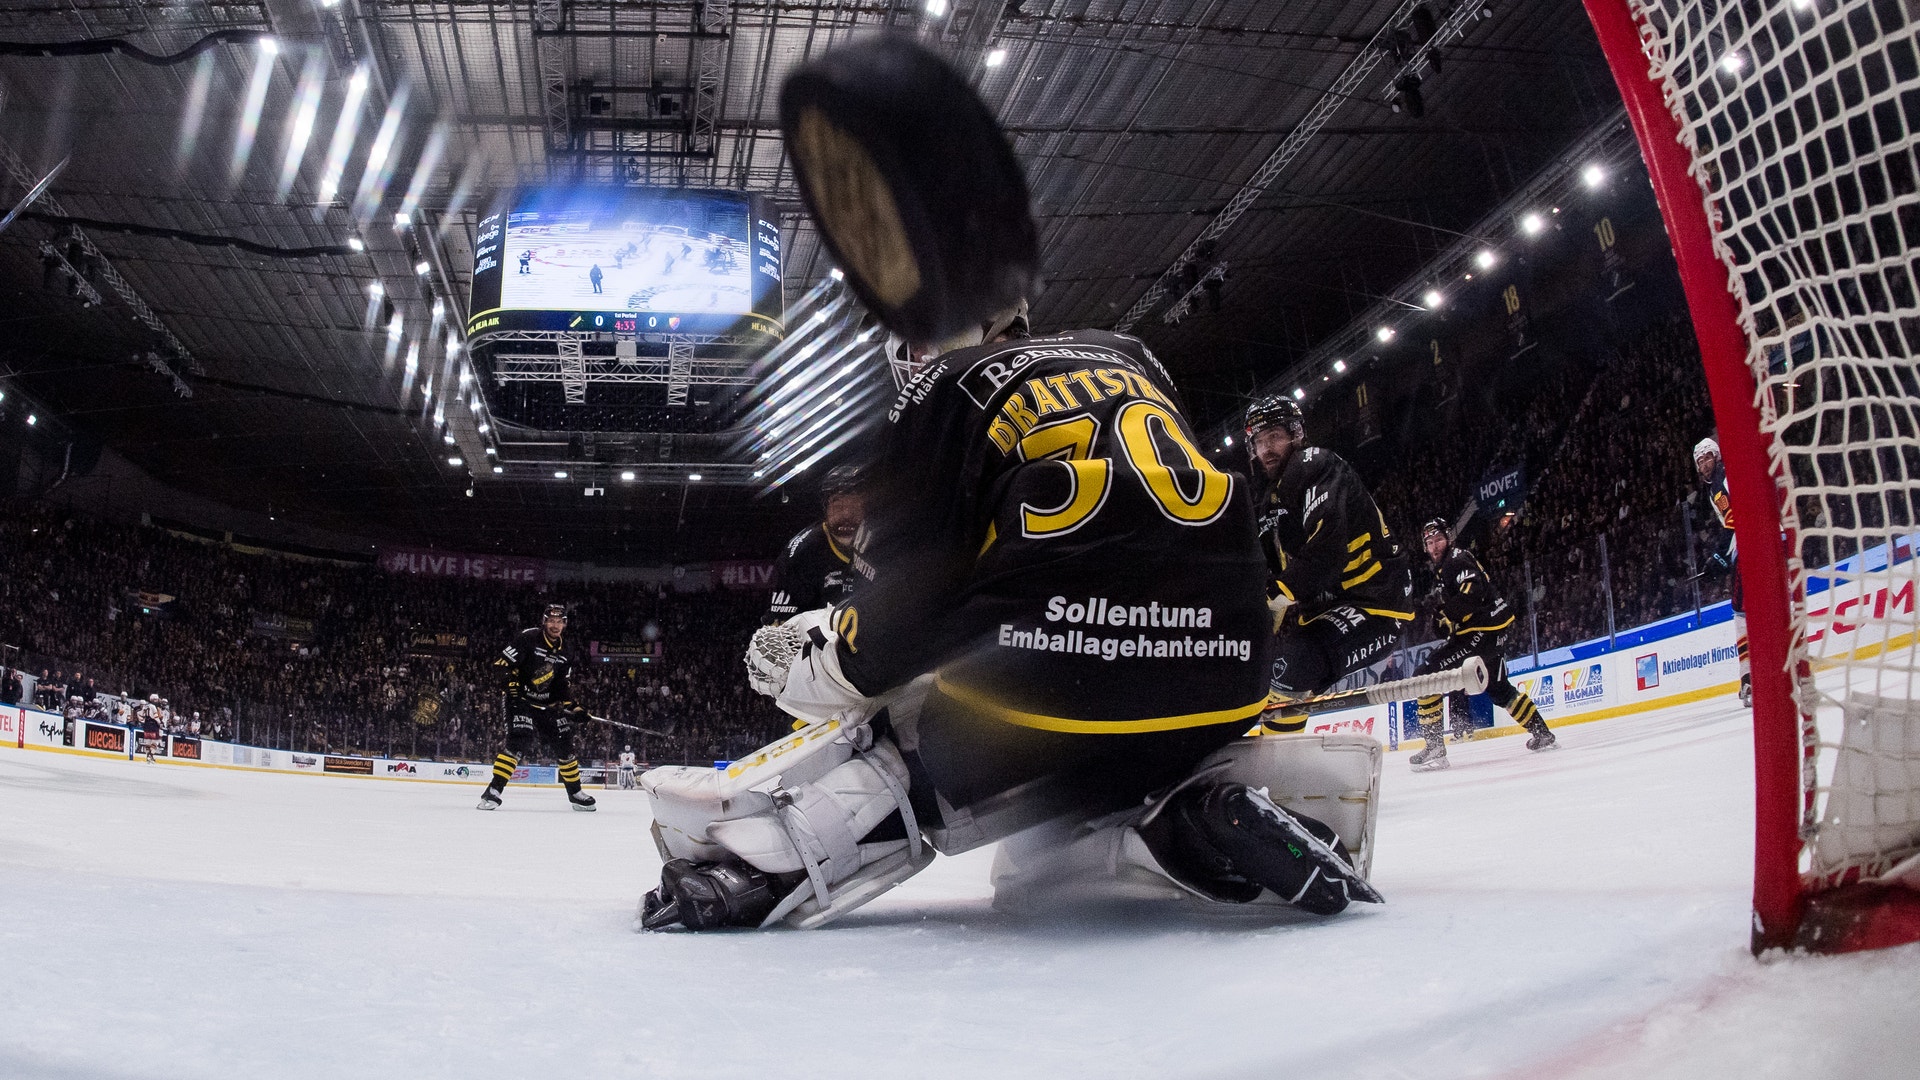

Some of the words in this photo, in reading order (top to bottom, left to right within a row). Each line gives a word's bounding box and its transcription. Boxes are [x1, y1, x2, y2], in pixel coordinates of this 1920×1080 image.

[477, 229, 500, 245] Fabege
[1593, 216, 1616, 252] 10
[1503, 284, 1521, 316] 18
[595, 315, 604, 327] 0
[614, 319, 636, 331] 4:33
[648, 316, 657, 328] 0
[911, 362, 949, 406] Måleri
[987, 367, 1178, 457] BRATTSTR
[1016, 398, 1235, 539] 30
[1479, 470, 1519, 501] HOVET
[463, 557, 486, 579] IS
[1045, 595, 1213, 629] Sollentuna
[998, 623, 1251, 662] Emballagehantering
[1662, 651, 1711, 676] Aktiebolaget
[1563, 684, 1604, 702] HAGMANS
[512, 714, 534, 725] ATM
[88, 729, 123, 751] wecall
[173, 741, 198, 758] wecall
